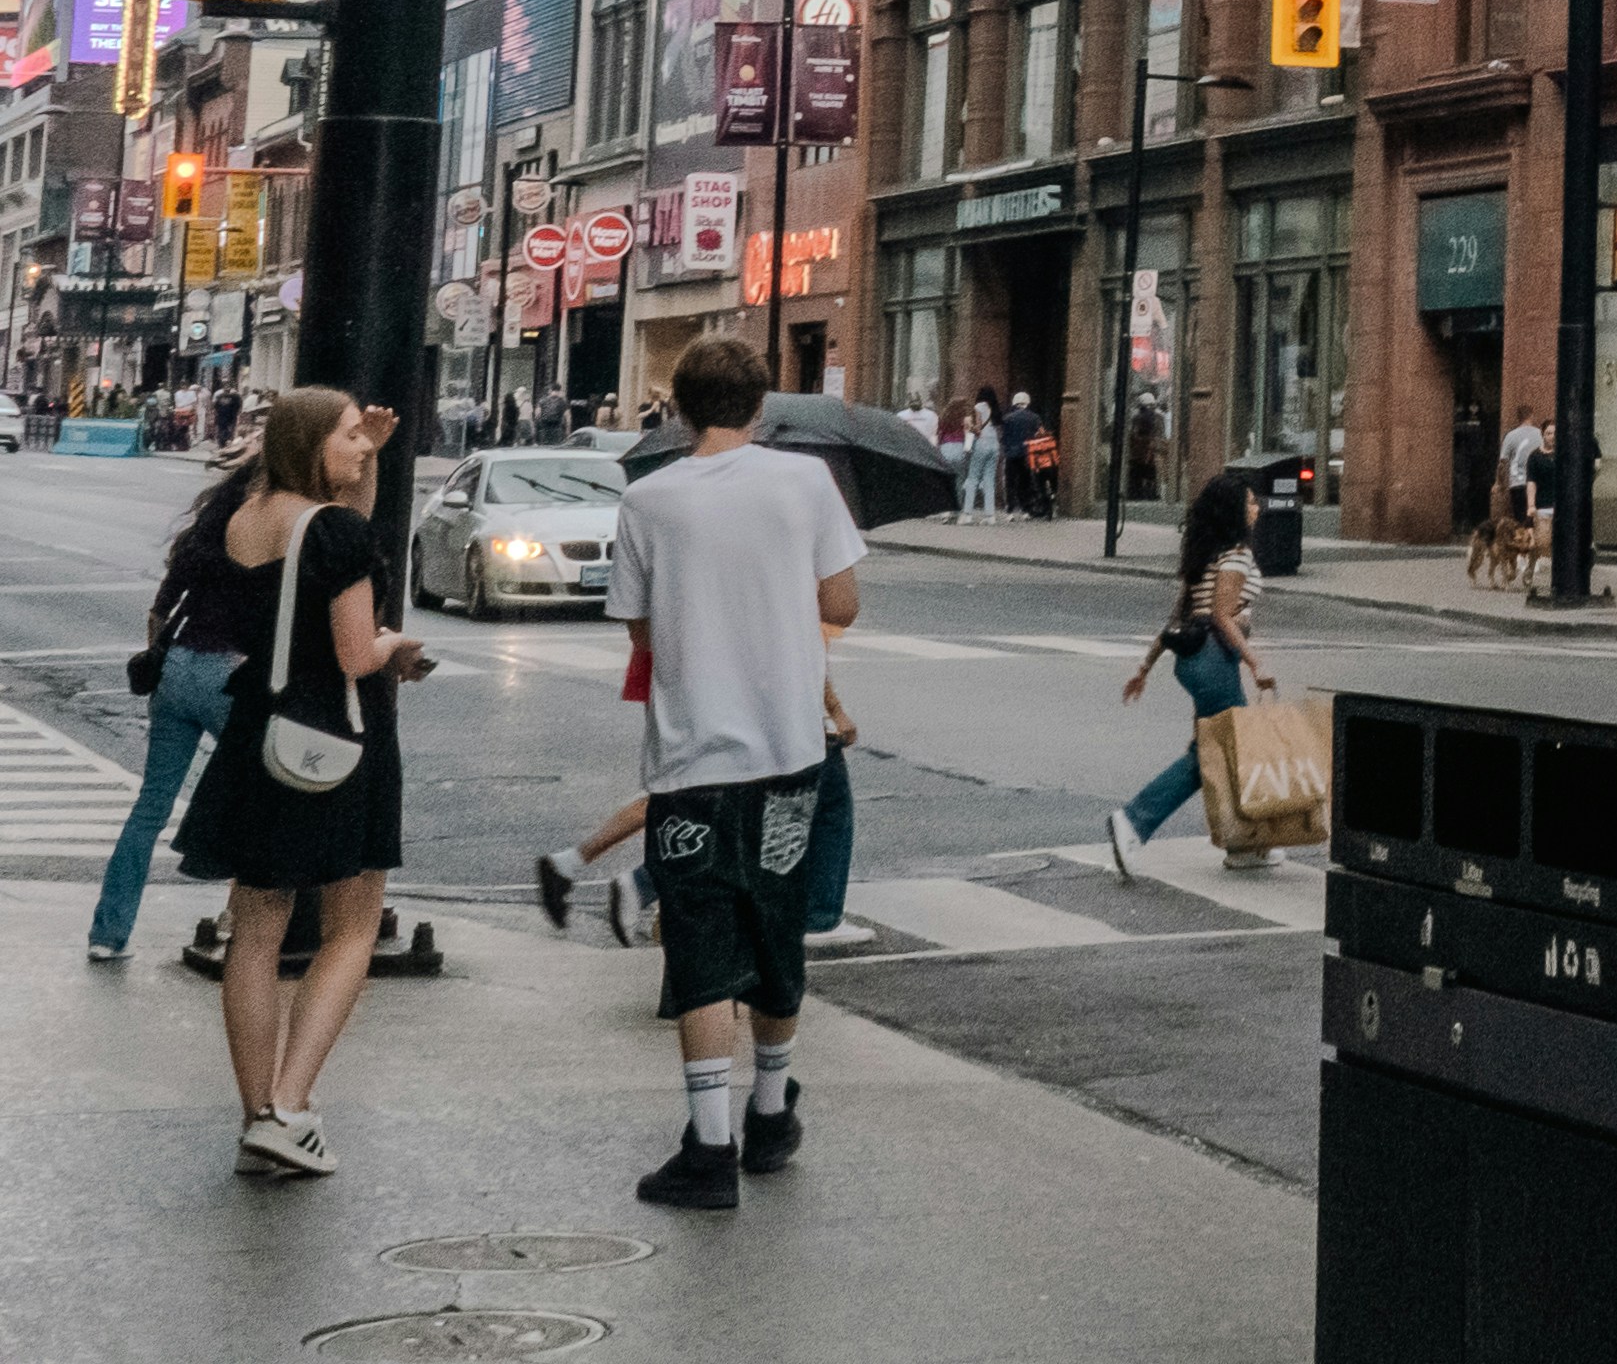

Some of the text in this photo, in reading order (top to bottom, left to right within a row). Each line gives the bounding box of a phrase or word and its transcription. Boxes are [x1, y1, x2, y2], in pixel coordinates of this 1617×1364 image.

[694, 181, 731, 193] STAG
[691, 195, 732, 208] SHOP
[1446, 235, 1480, 276] 229
